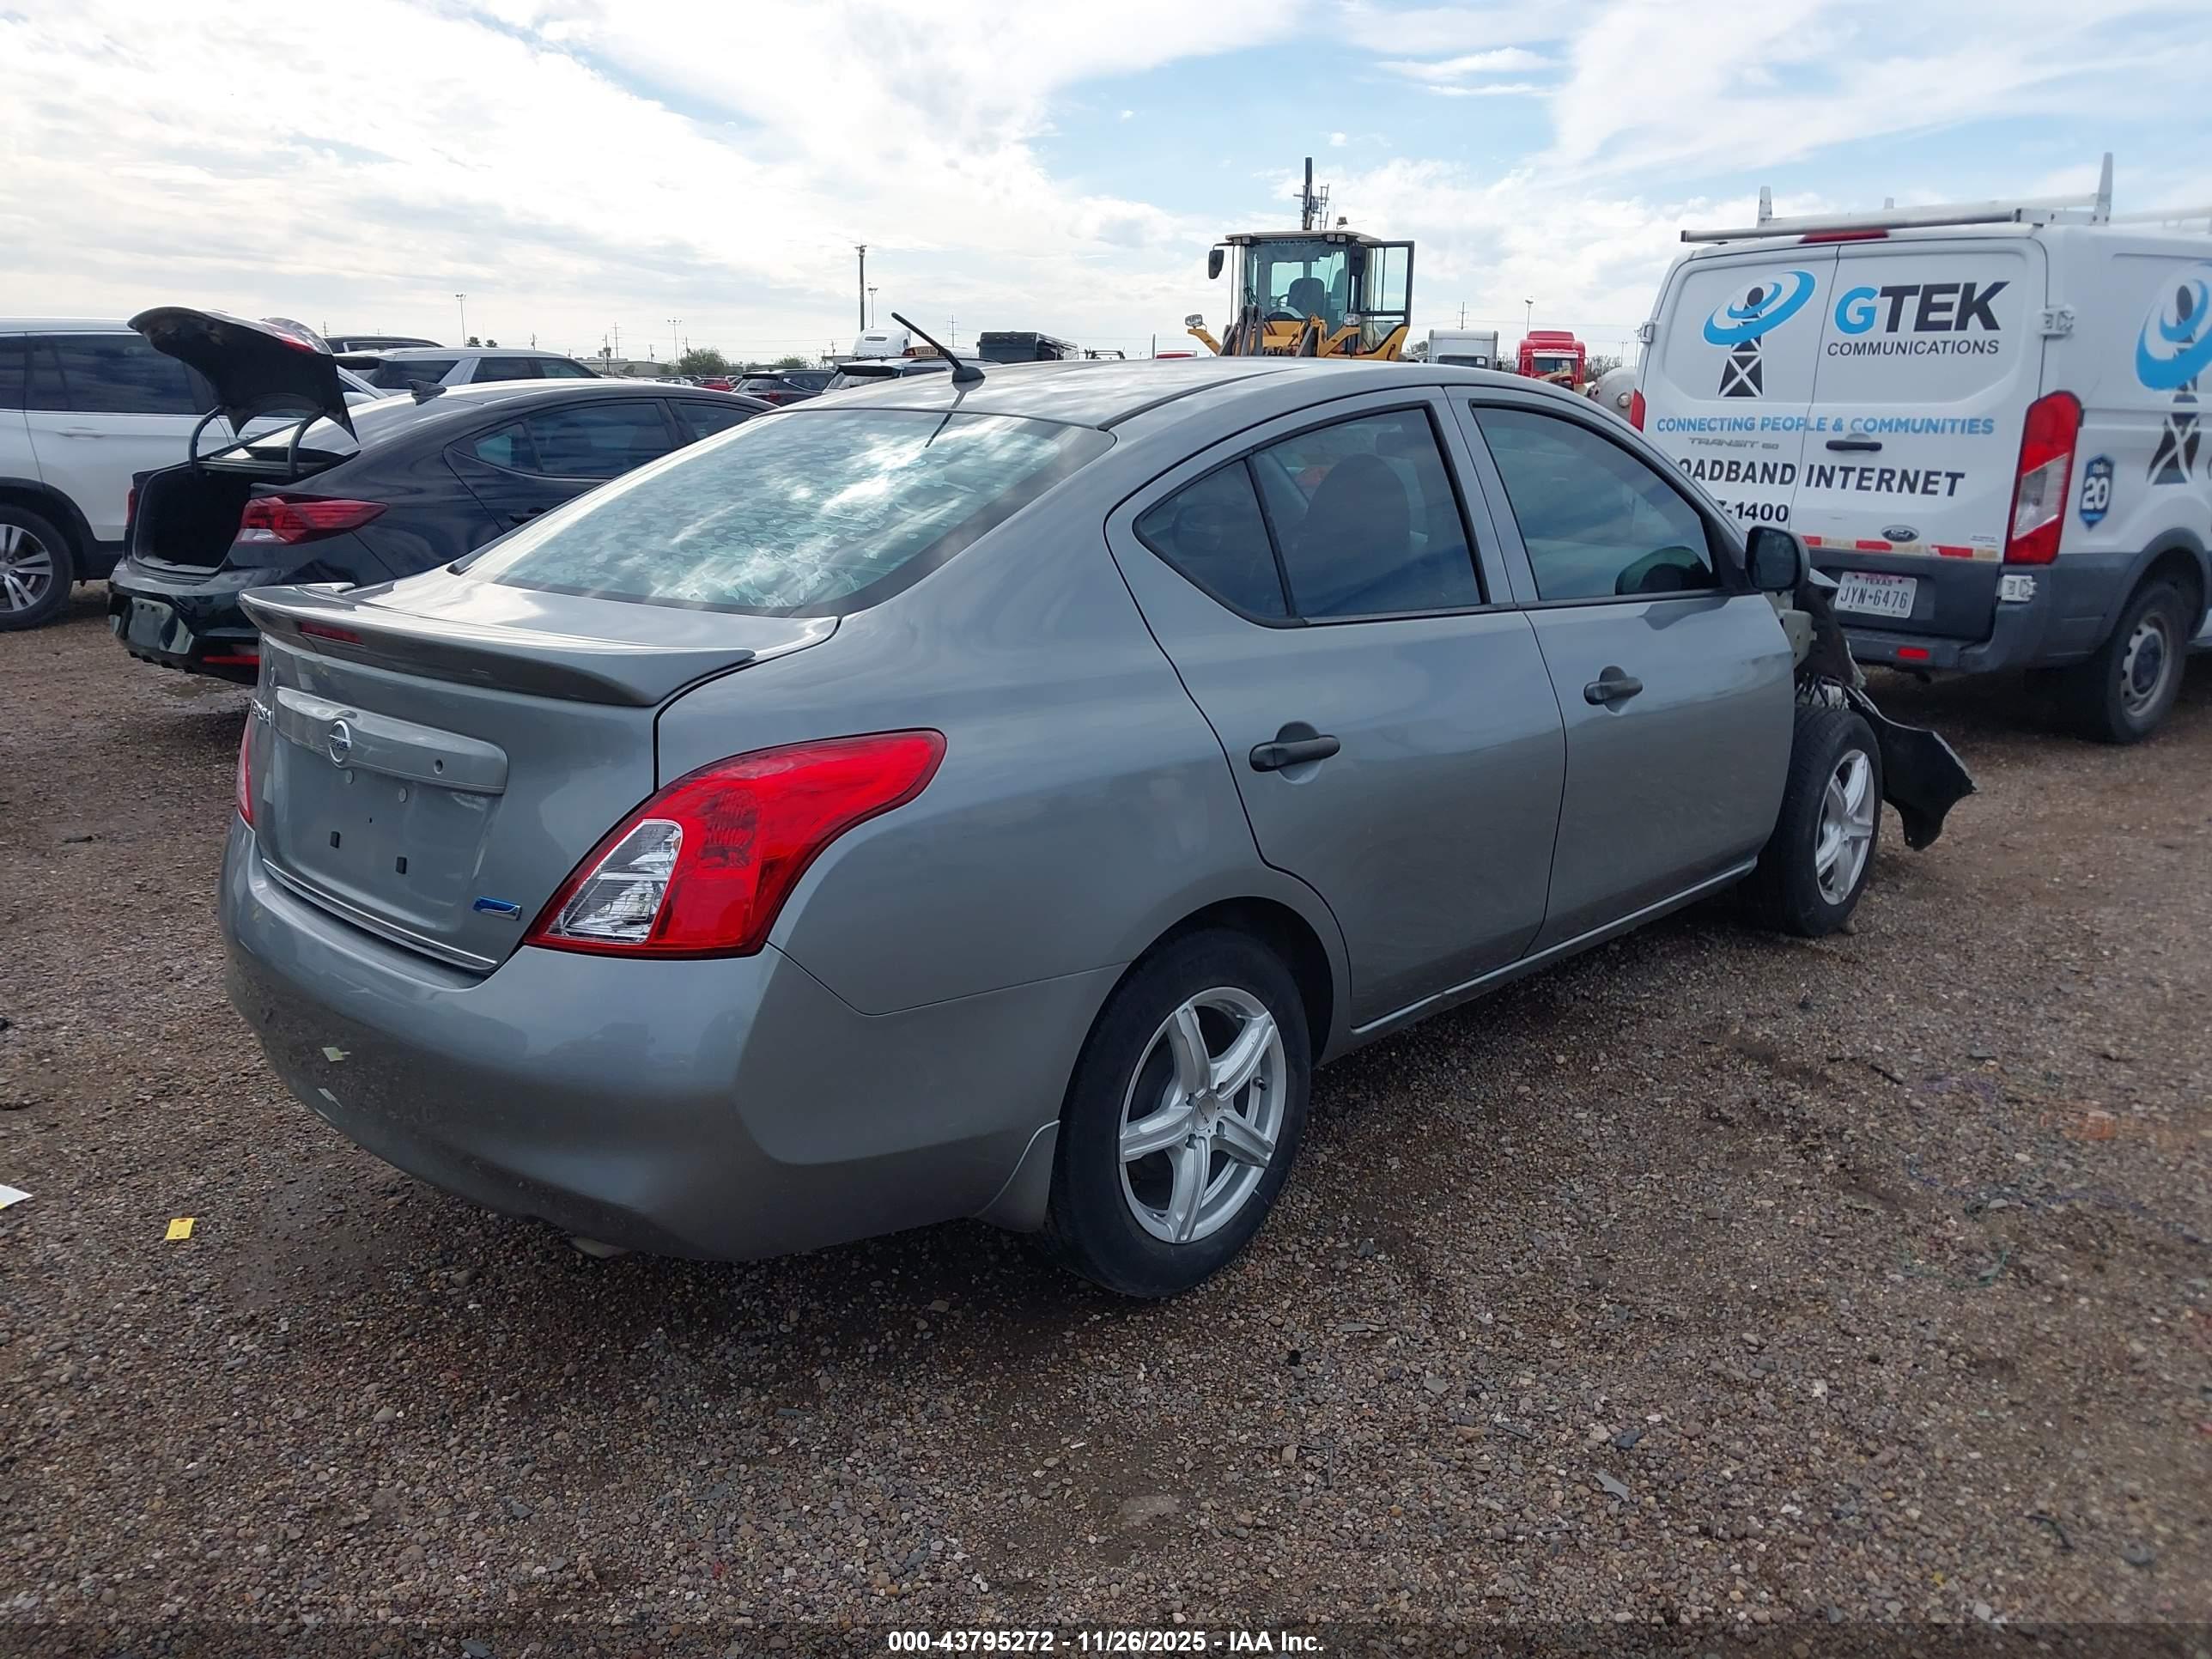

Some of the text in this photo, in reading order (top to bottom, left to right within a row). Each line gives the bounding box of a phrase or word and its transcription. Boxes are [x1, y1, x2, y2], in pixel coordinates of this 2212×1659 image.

[1834, 281, 2010, 335] GTEK
[1827, 340, 1999, 356] COMMUNICATIONS
[1656, 416, 1994, 434] CONNECTING PEOPLE & COMMUNITIES
[1688, 437, 1759, 448] TRANSIT
[1805, 464, 1966, 497] INTERNET
[2081, 476, 2110, 510] 20
[1865, 578, 1893, 587] TEXAS
